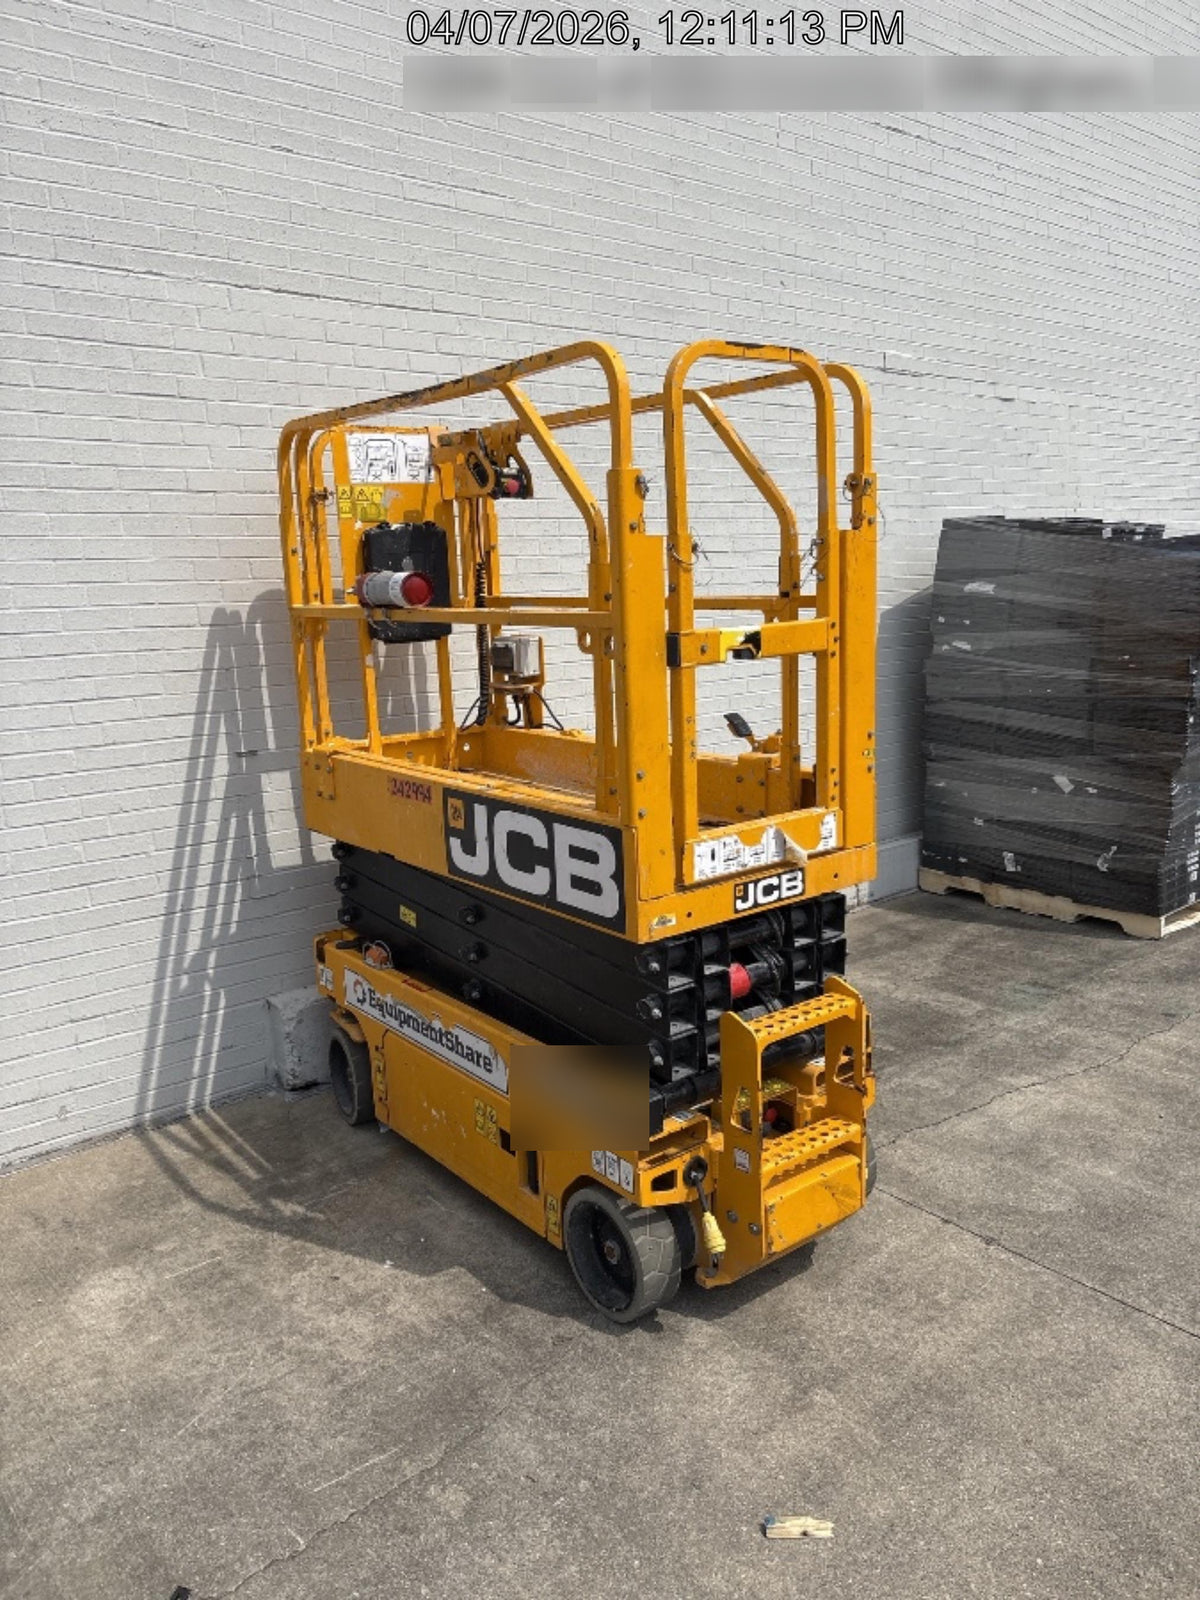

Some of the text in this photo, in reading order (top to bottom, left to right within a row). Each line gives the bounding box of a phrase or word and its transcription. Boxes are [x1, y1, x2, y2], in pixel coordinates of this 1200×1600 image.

[449, 803, 620, 919] JCB
[736, 870, 804, 912] JCB
[368, 987, 494, 1074] EquipmentShare
